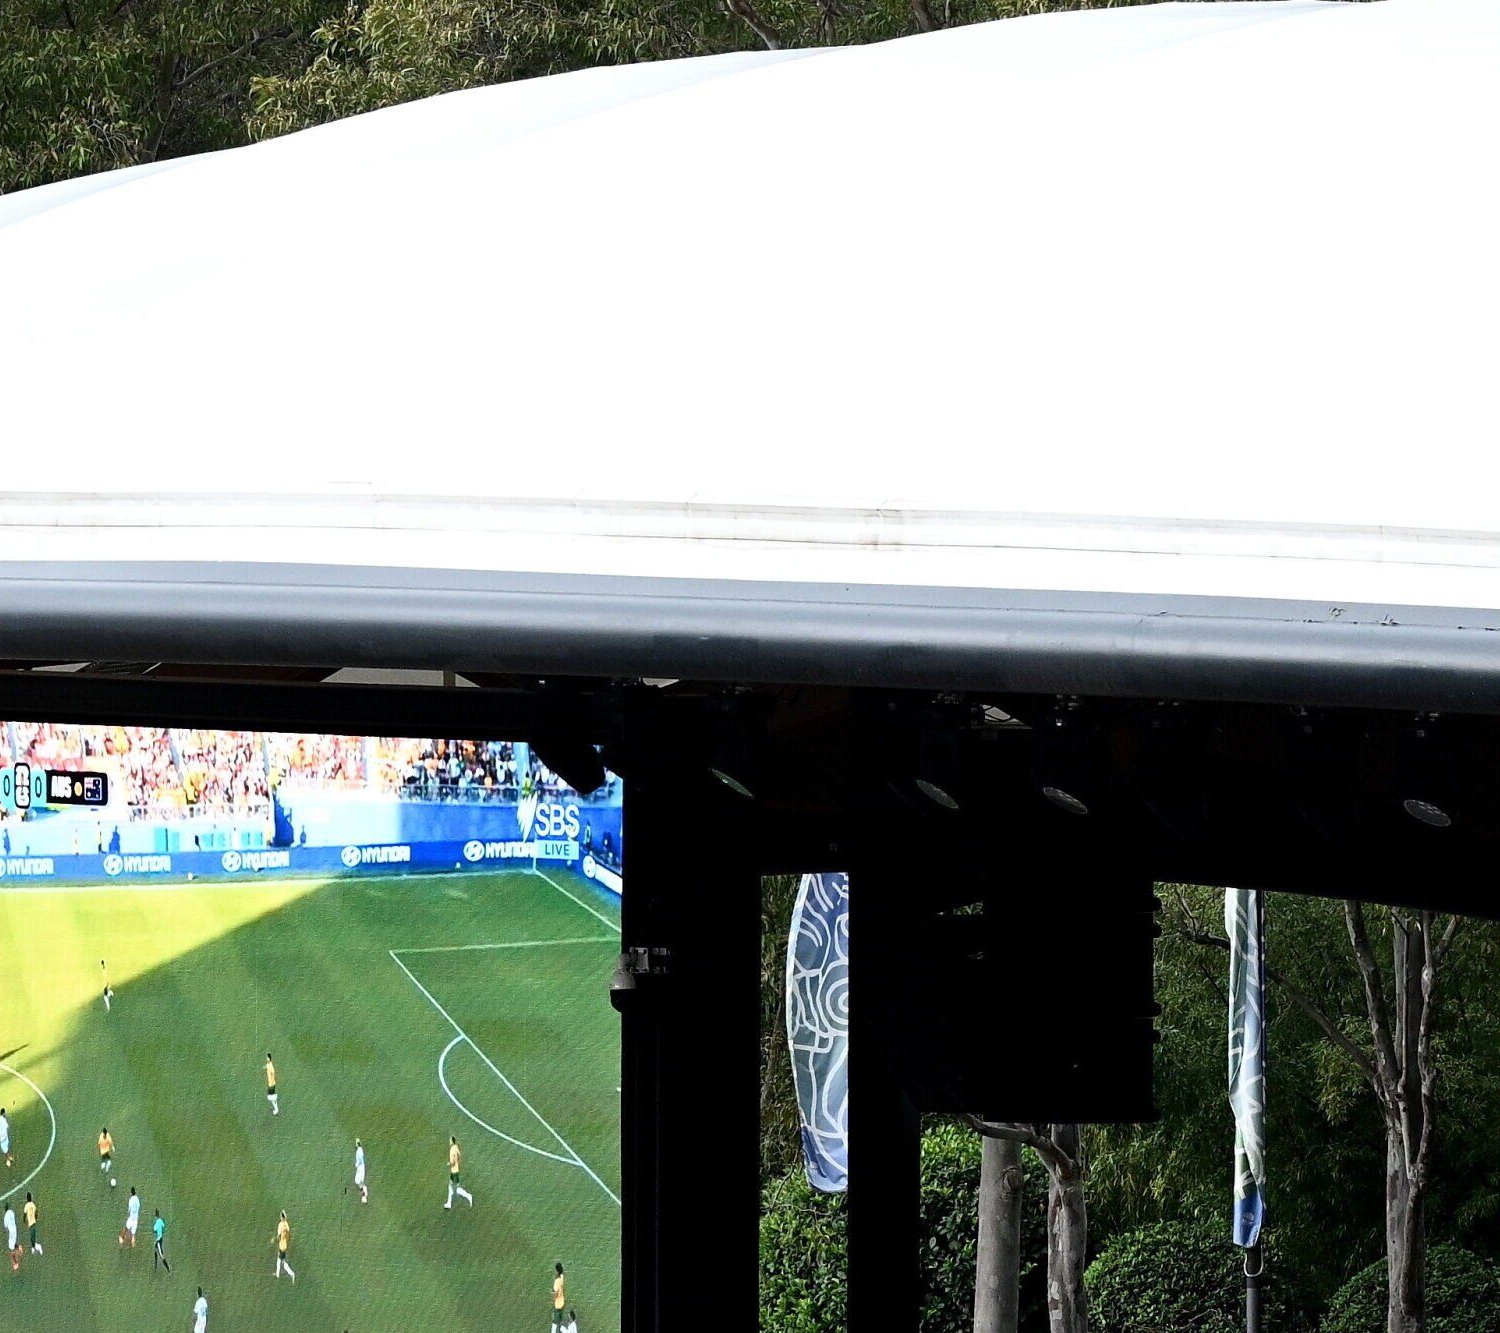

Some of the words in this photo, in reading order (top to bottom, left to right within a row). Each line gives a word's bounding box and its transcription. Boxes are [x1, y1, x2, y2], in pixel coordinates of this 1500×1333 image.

[3, 775, 11, 796] 0
[35, 776, 42, 797] 0
[51, 775, 72, 798] AUS
[534, 803, 580, 838] SBS
[361, 846, 410, 863] HYUNDAI
[544, 843, 570, 856] LIVE
[6, 858, 54, 875] HYUNDAI
[123, 856, 171, 872] HYUNDAI
[241, 851, 289, 870] HYUNDAI
